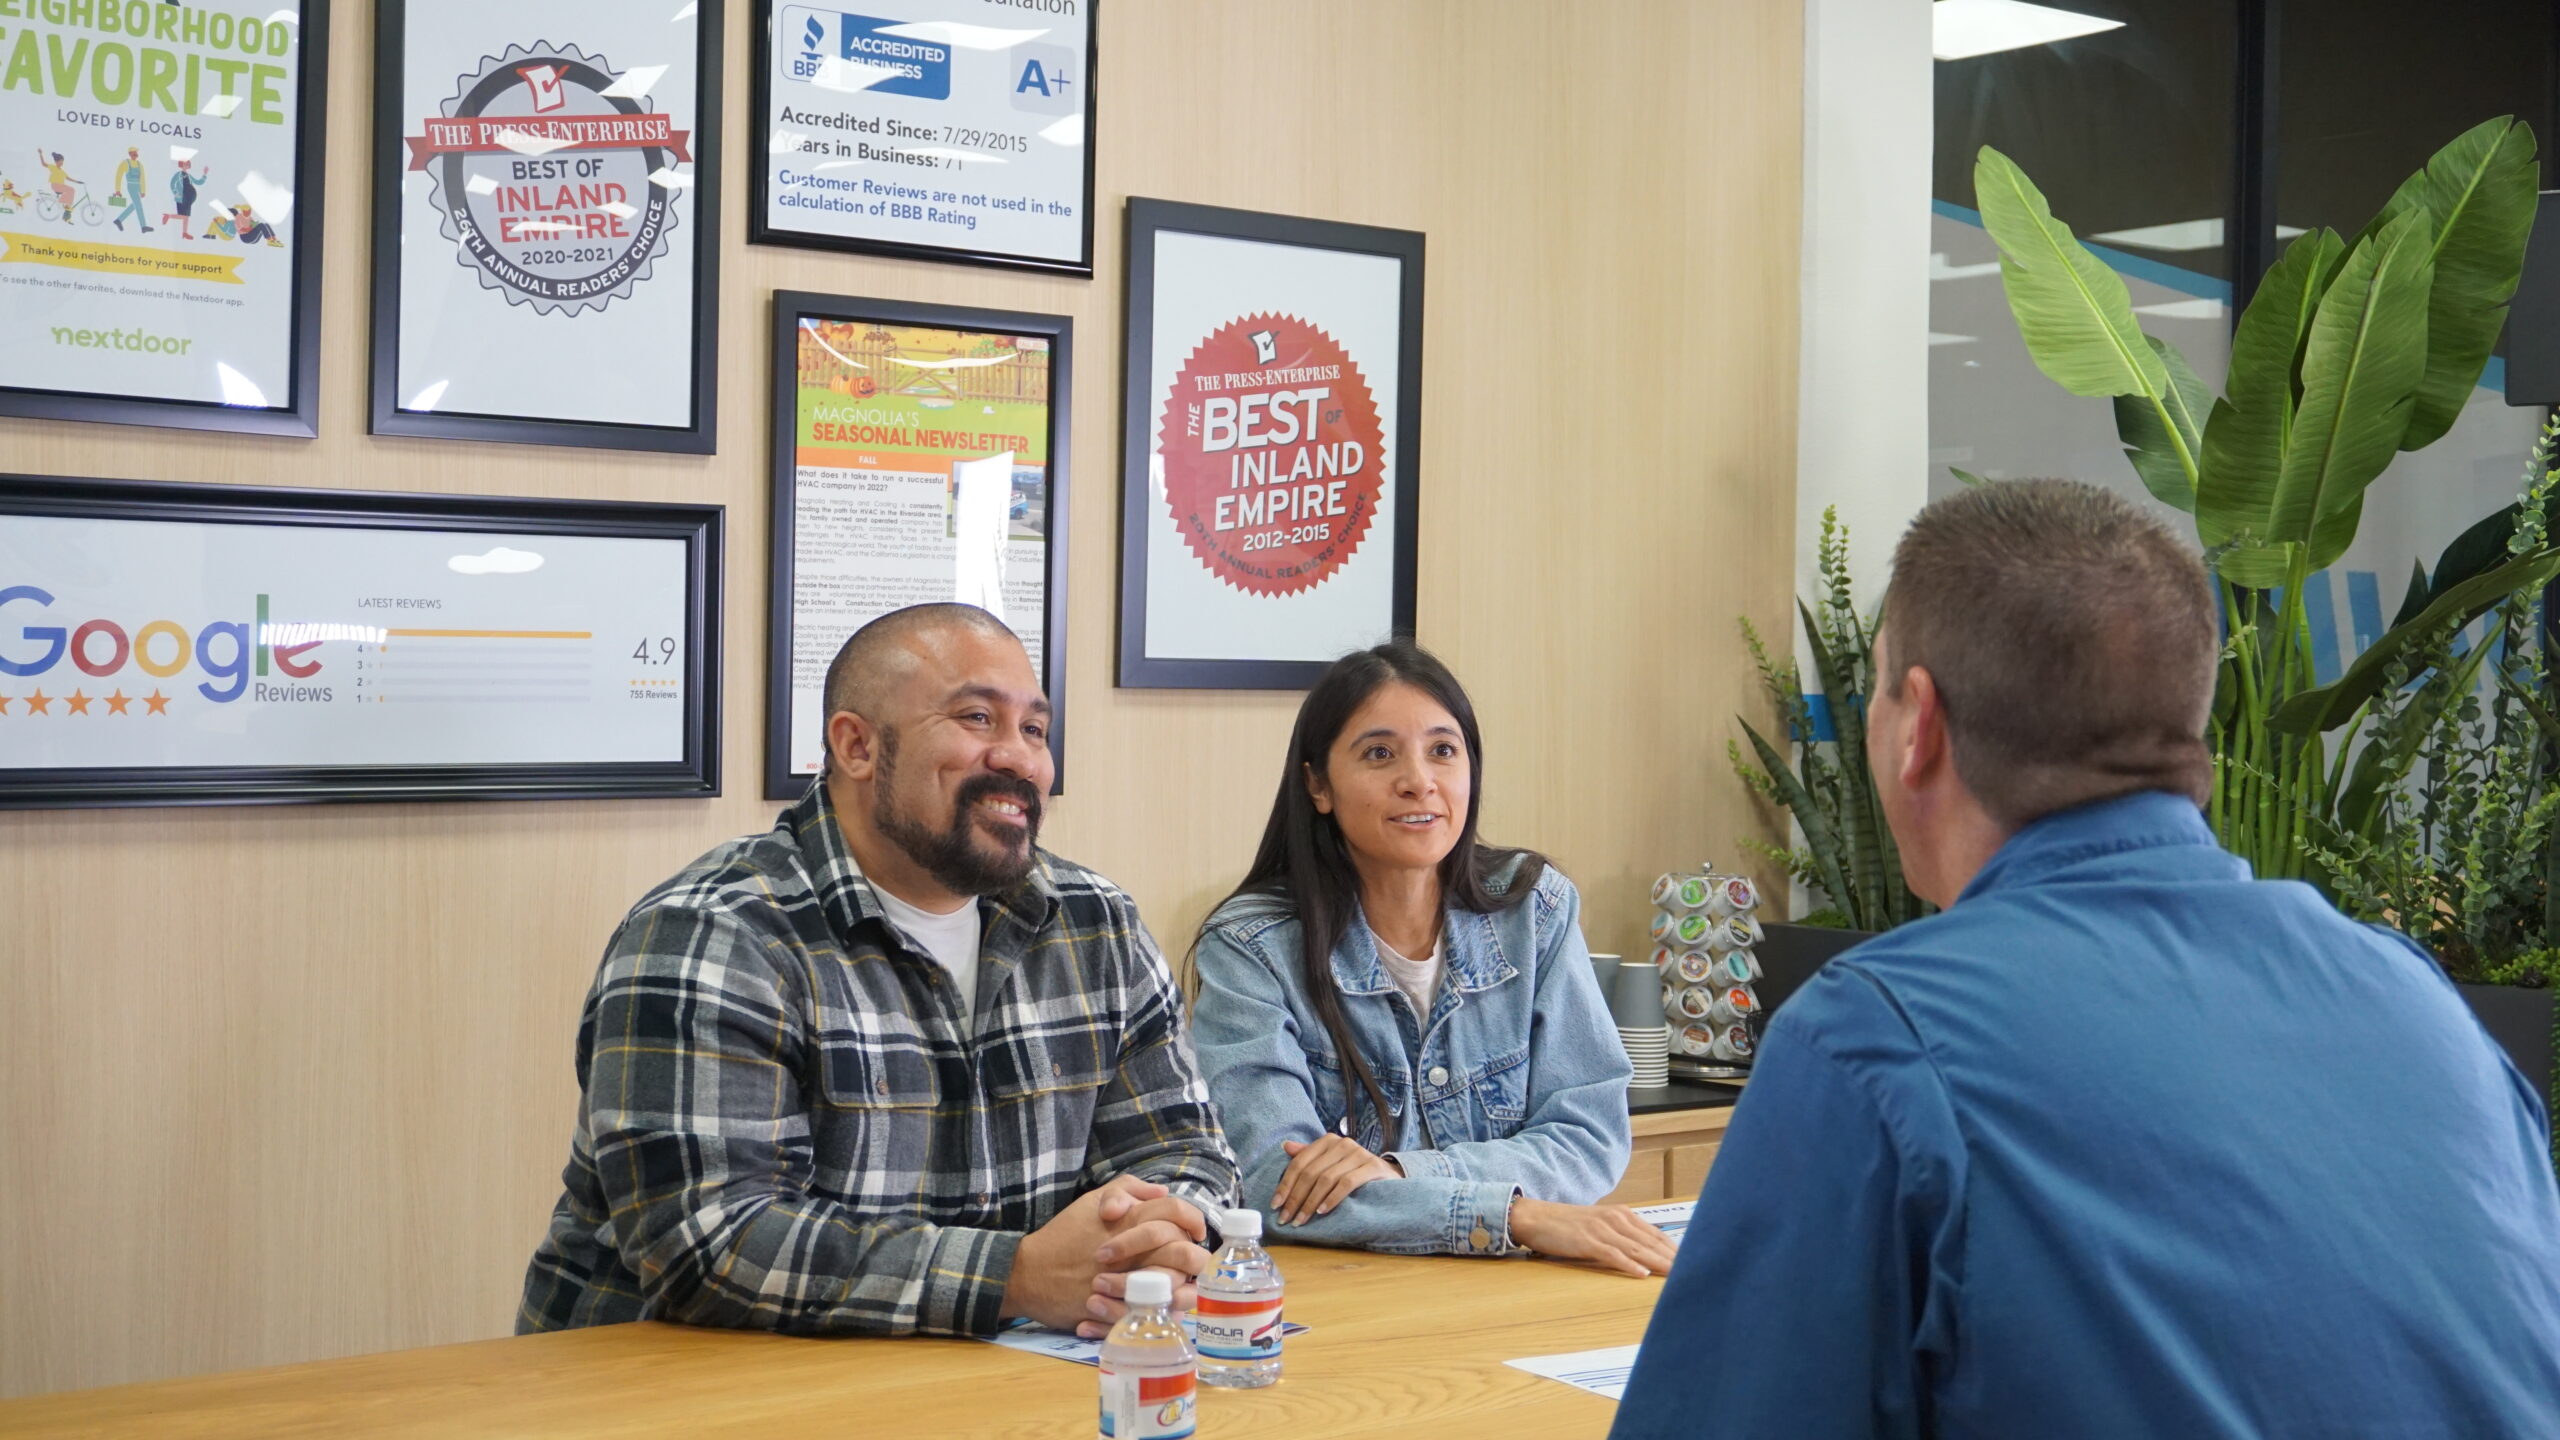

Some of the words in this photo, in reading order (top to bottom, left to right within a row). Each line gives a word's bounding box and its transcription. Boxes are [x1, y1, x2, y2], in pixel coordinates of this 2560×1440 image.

[0, 0, 288, 56] EIGHBORHOOD
[850, 36, 945, 63] ACCREDITED
[0, 26, 287, 125] AVORITE
[794, 60, 821, 77] BB
[1015, 59, 1071, 97] A+
[58, 109, 111, 127] LOVED
[116, 116, 135, 131] BY
[140, 120, 202, 140] LOCALS
[429, 124, 473, 146] THE
[479, 119, 669, 146] PRESS-ENTERPRISE
[780, 106, 880, 134] Accredited
[886, 120, 938, 142] Since:
[943, 126, 1028, 154] 7/29/2015
[836, 139, 851, 157] in
[858, 142, 938, 168] Business:
[512, 160, 569, 180] BEST
[576, 158, 604, 178] OF
[496, 183, 627, 213] INLAND
[779, 169, 858, 192] Customer
[863, 180, 928, 201] Reviews
[932, 190, 957, 204] are
[961, 190, 987, 207] not
[992, 194, 1026, 212] used
[1031, 198, 1044, 213] in
[1048, 197, 1072, 217] the
[779, 192, 864, 216] calculation
[869, 200, 885, 216] of
[890, 204, 923, 220] BBB
[927, 208, 977, 231] Rating
[500, 213, 630, 243] EMPIRE
[21, 243, 55, 257] Thank
[57, 250, 78, 260] you
[81, 252, 135, 266] neighbors
[137, 256, 153, 267] for
[155, 259, 180, 271] your
[181, 260, 223, 275] support
[453, 208, 486, 254] 26TH
[483, 254, 551, 296] ANNUAL
[556, 260, 631, 297] READERS'
[631, 200, 663, 261] CHOICE
[521, 248, 614, 265] 2020-2021
[11, 277, 27, 286] see
[29, 276, 45, 287] the
[46, 279, 71, 290] other
[74, 281, 117, 294] favorites,
[119, 285, 164, 299] download
[165, 289, 181, 301] the
[182, 291, 224, 304] Nextdoor
[226, 296, 246, 308] app.
[50, 326, 192, 356] nextdoor
[1194, 374, 1221, 392] THE
[1225, 363, 1340, 389] PRESS-ENTERPRISE
[813, 407, 919, 428] MAGNOLIA'S
[1187, 402, 1201, 438] THE
[1202, 386, 1330, 452] BEST
[812, 422, 912, 446] SEASONAL
[915, 429, 1030, 454] NEWSLETTER
[858, 455, 878, 464] FALL
[1230, 440, 1364, 489] INLAND
[797, 470, 817, 478] What
[820, 471, 839, 479] does
[851, 472, 867, 480] take
[871, 473, 879, 481] to
[907, 476, 944, 484] successful
[797, 480, 819, 488] HVAC
[821, 482, 857, 491] company
[867, 484, 888, 492] 2022?
[797, 506, 820, 514] leading
[834, 507, 848, 515] path
[909, 503, 943, 511] consistently
[1214, 480, 1347, 532] EMPIRE
[871, 517, 898, 525] operated
[1218, 550, 1273, 579] ANNUAL
[1276, 543, 1336, 579] READERS'
[1337, 491, 1368, 544] CHOICE
[1242, 523, 1330, 552] 2012-2015
[358, 599, 394, 608] LATEST
[396, 599, 442, 609] REVIEWS
[0, 585, 323, 703] Google
[632, 637, 676, 665] 4.9
[255, 682, 333, 702] Reviews
[630, 690, 643, 699] 755
[645, 690, 678, 699] Reviews
[1196, 1321, 1244, 1338] AGNOLIA
